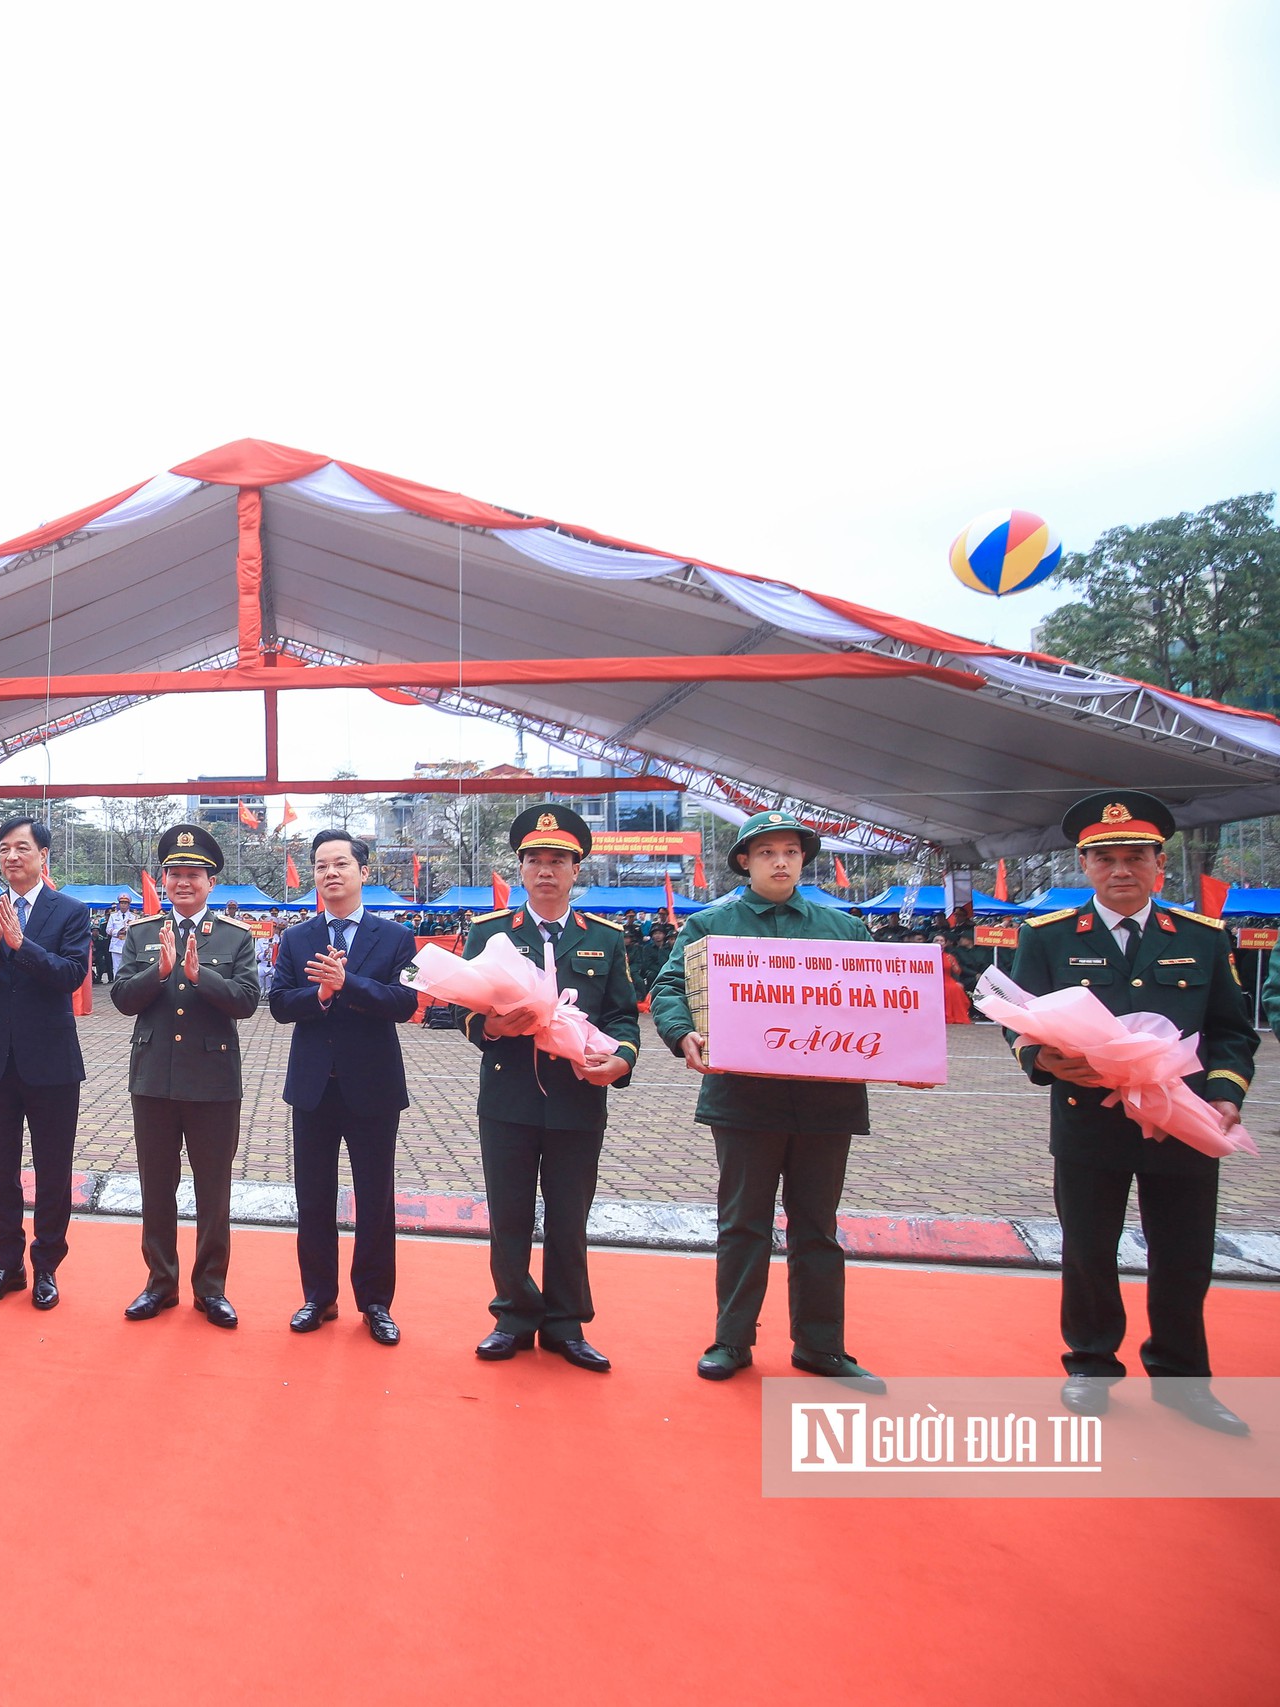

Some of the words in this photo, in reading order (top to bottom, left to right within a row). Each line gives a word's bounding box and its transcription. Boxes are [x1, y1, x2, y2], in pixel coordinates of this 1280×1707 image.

[712, 952, 744, 967] THÀNH
[747, 950, 759, 968] ỦY
[769, 955, 795, 970] HĐND
[805, 957, 832, 971] UBND
[842, 958, 882, 974] UBMTTQ
[885, 957, 906, 976] VIỆT
[910, 960, 934, 974] NAM
[730, 980, 795, 1005] THÀNH
[802, 980, 842, 1006] PHỐ
[849, 984, 877, 1008] HÀ
[883, 986, 919, 1013] NỘI
[764, 1025, 884, 1060] TẶNG
